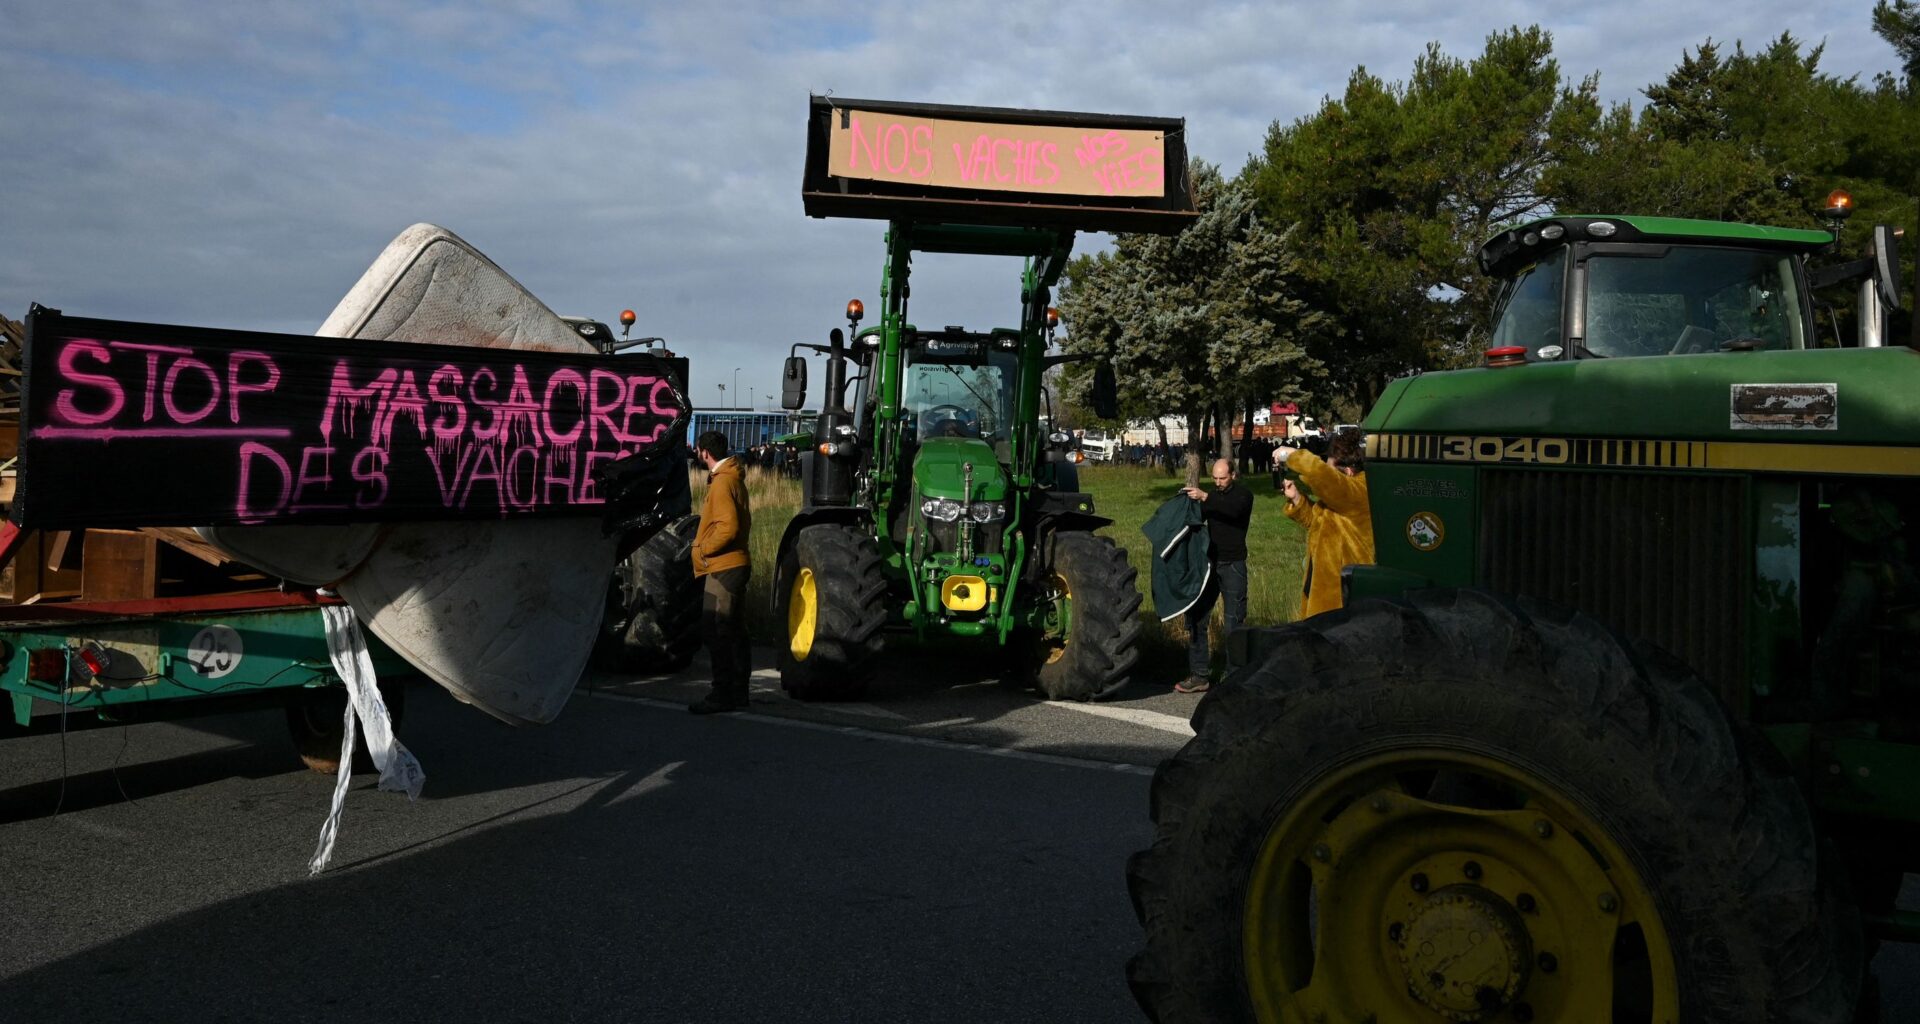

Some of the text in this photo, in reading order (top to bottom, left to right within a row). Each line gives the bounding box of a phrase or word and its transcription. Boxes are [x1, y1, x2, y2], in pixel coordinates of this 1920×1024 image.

[849, 118, 1062, 186] NOS VACHES
[1074, 131, 1129, 168] NOS
[52, 336, 680, 447] STOP MASSACRES
[1443, 436, 1569, 464] 3040
[234, 440, 640, 524] DES VACHE
[200, 631, 232, 672] 25
